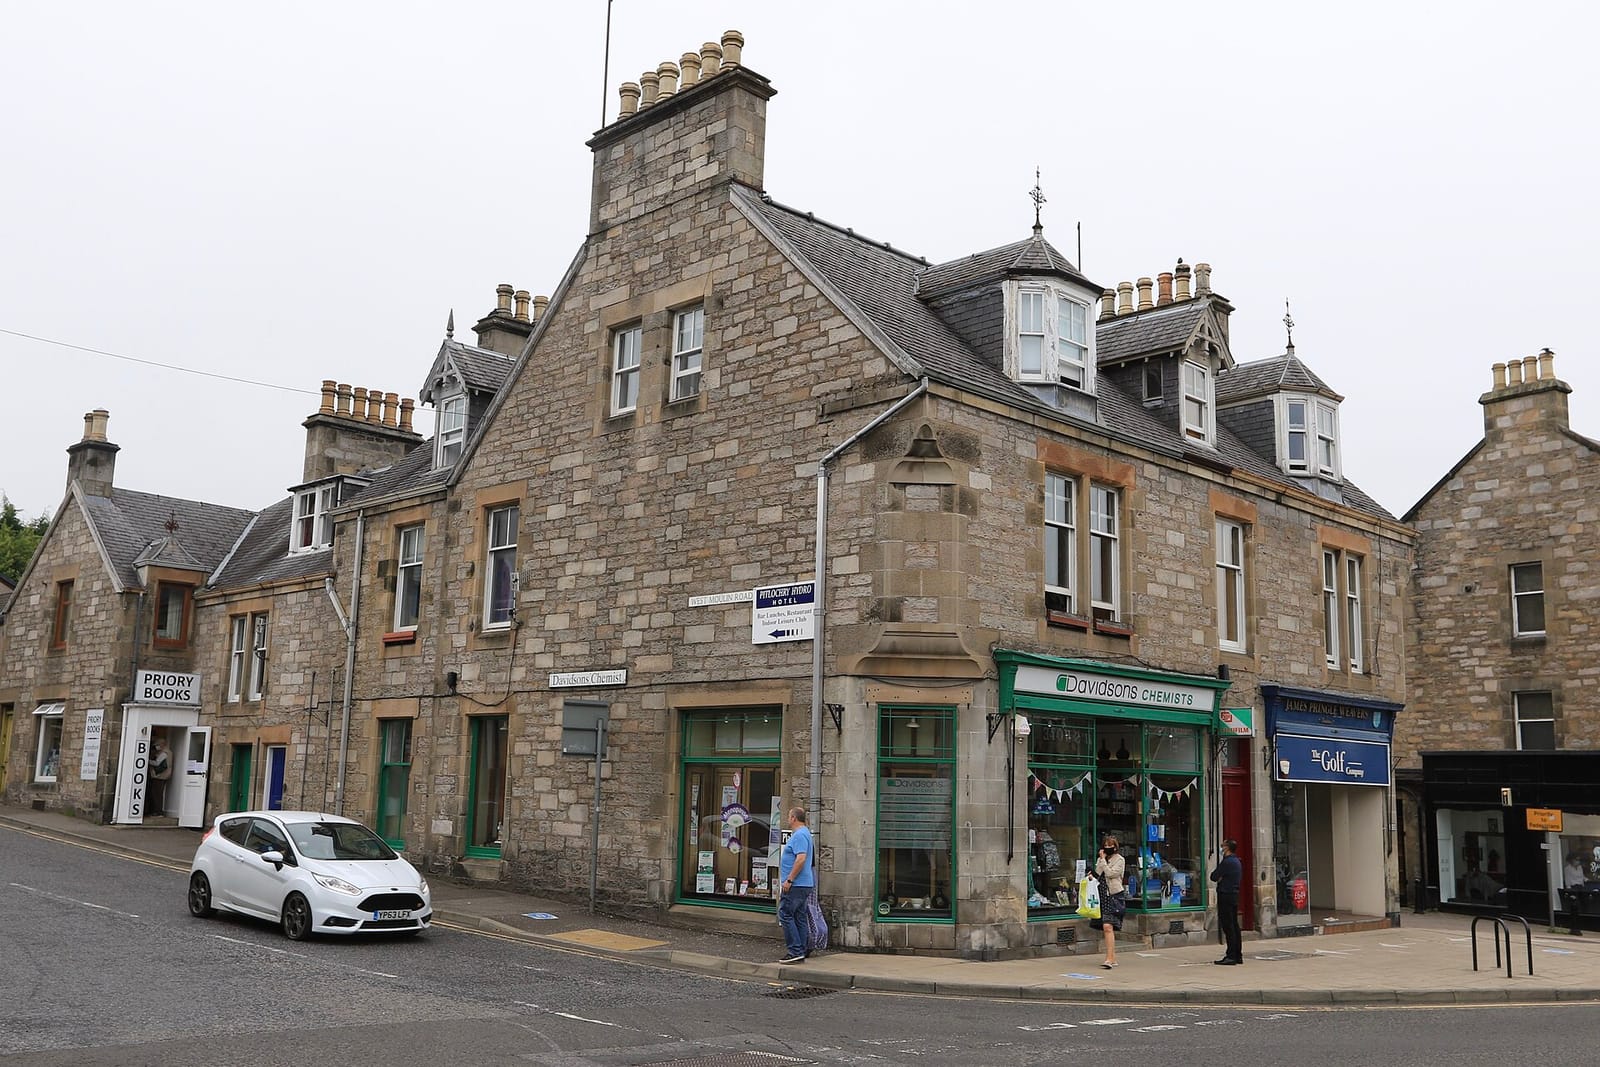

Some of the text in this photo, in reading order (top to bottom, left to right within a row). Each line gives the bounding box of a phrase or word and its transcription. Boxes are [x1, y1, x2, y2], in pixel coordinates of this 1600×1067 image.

[691, 592, 753, 605] WEST MOULIN ROAD
[760, 585, 812, 599] PITLOCHRY HYDRO
[773, 597, 797, 605] HOTEL
[144, 673, 194, 687] PRIORY
[553, 672, 622, 685] Davidsons Chemist
[144, 688, 191, 700] BOOKS
[1066, 675, 1193, 705] Davidsons CHEMISTS
[1285, 699, 1369, 719] JAMES PRINGLE WEAVERS
[87, 725, 101, 733] BOOKS
[1312, 749, 1321, 759] The
[1321, 750, 1346, 773] Golf
[131, 742, 147, 816] BOOKS
[896, 779, 944, 788] Davidsons
[379, 910, 411, 919] YP63 LFX
